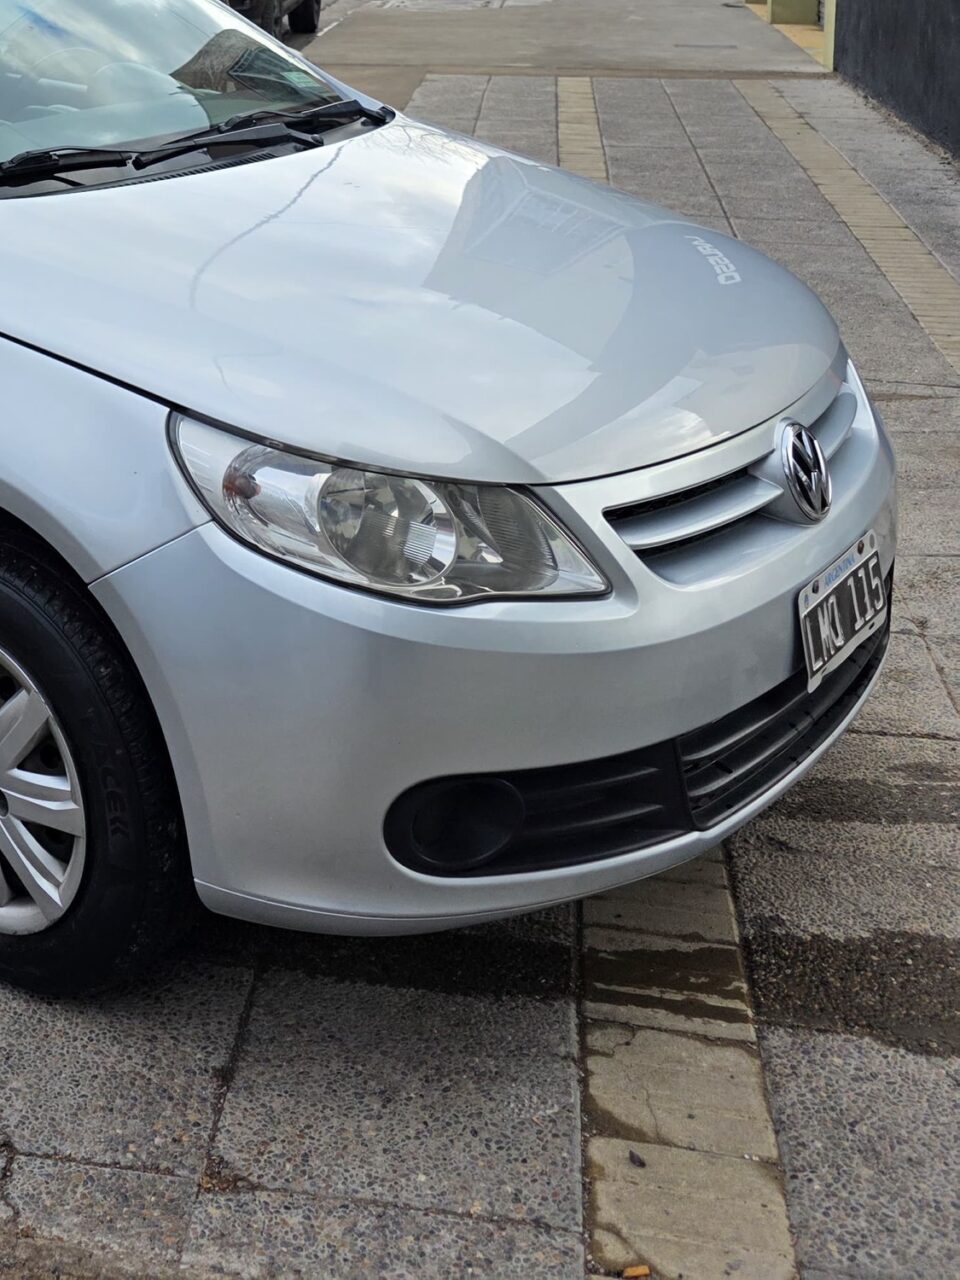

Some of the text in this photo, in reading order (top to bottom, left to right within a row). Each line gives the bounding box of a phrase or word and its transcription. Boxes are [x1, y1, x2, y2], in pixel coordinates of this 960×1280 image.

[823, 553, 856, 588] ARGENTINA
[806, 555, 884, 671] LMQ 115
